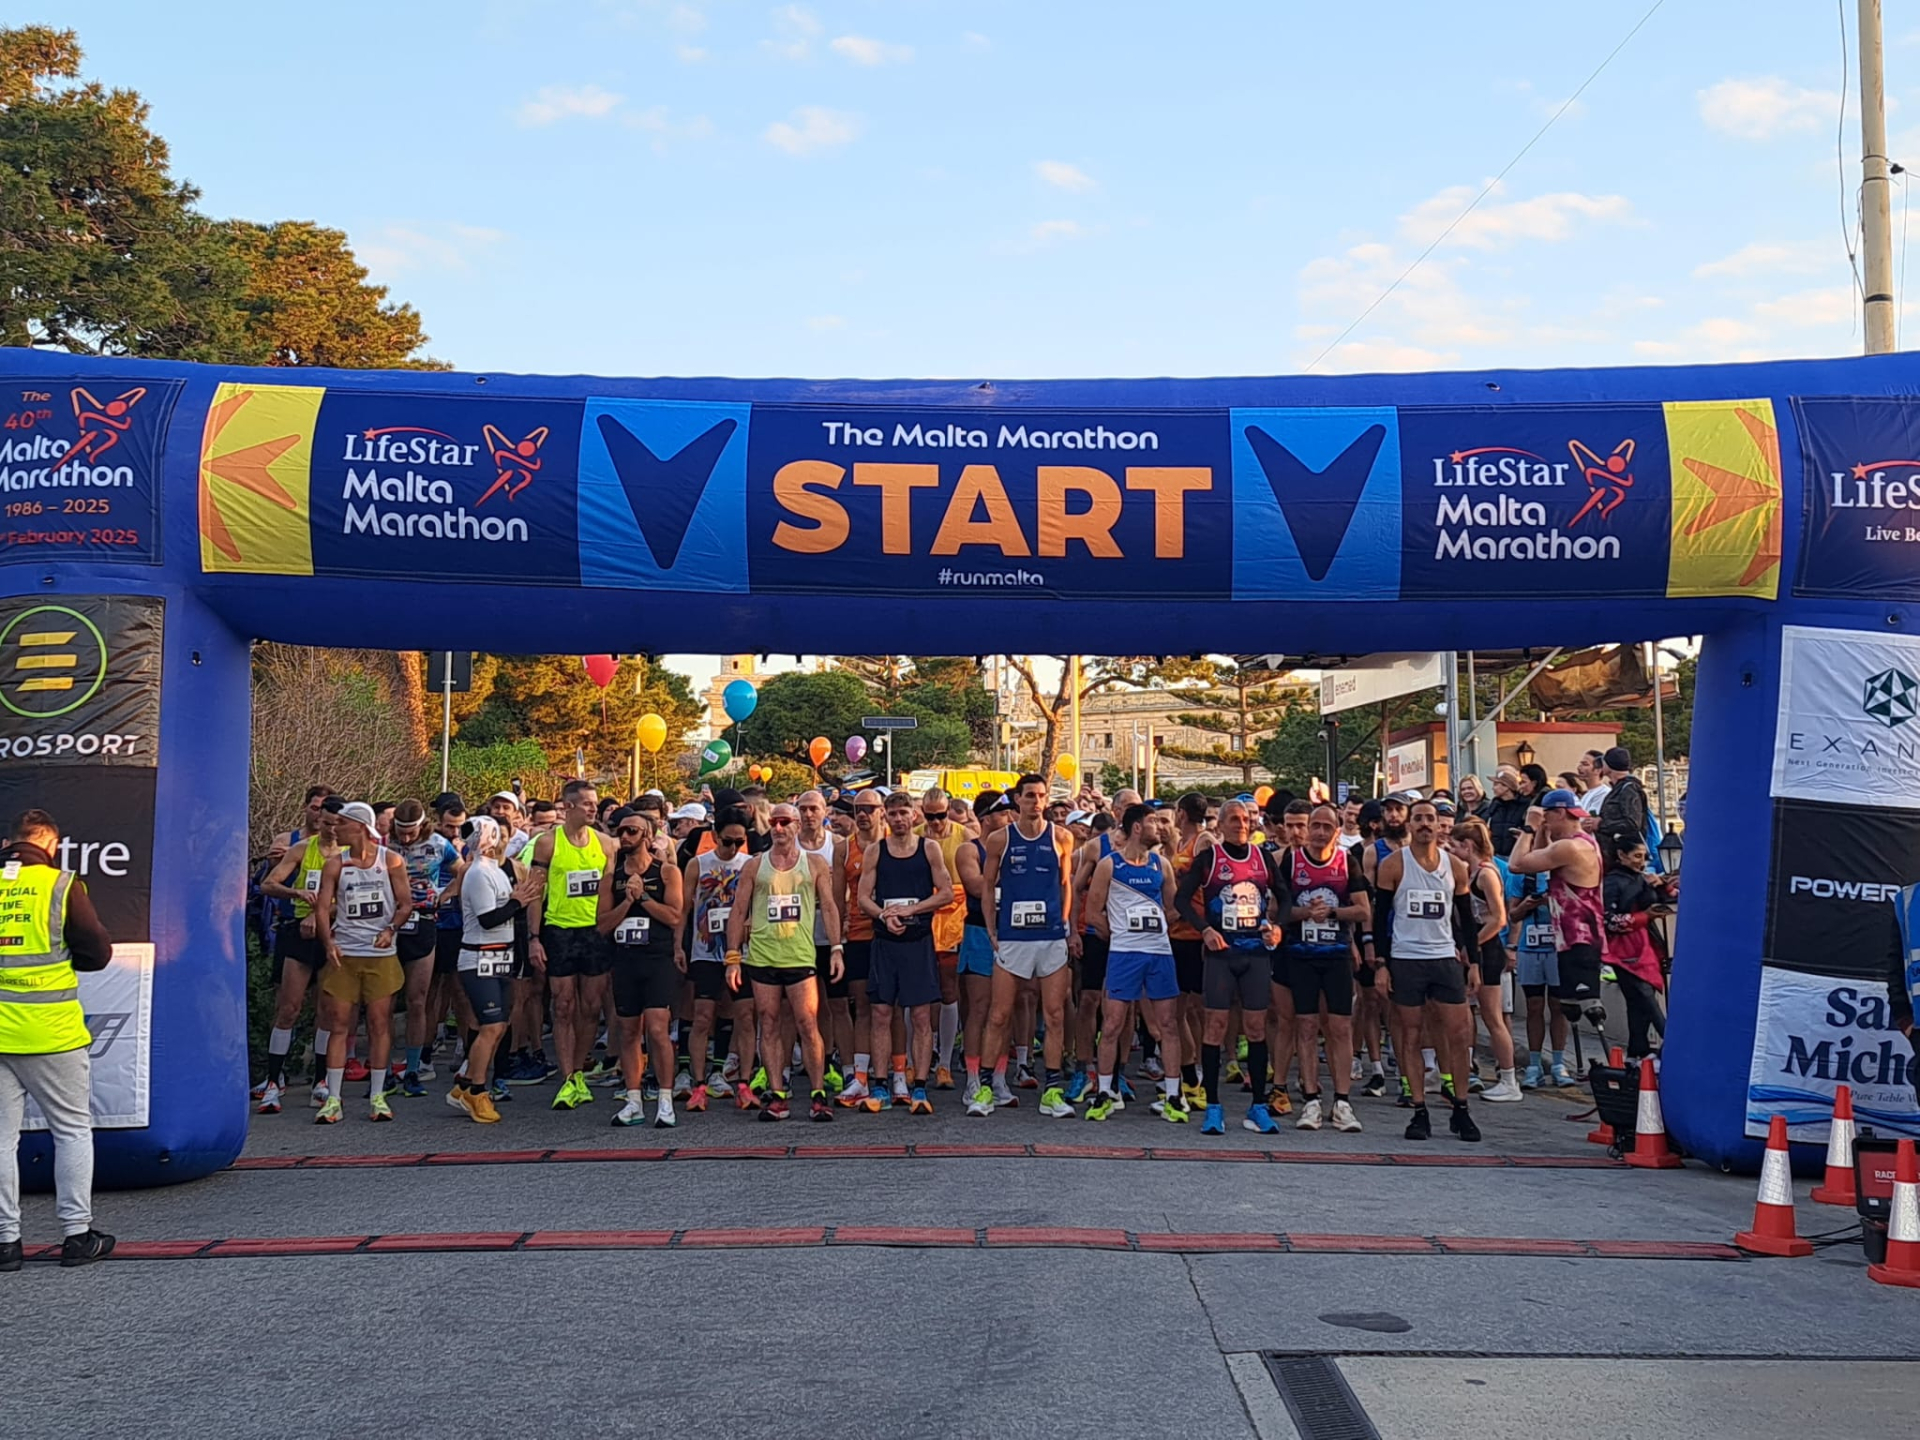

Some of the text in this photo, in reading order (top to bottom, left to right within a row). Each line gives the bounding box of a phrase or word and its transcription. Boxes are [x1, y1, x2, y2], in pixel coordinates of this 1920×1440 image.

[22, 391, 51, 401] The
[4, 410, 52, 430] 40th
[823, 422, 1159, 450] The Malta Marathon
[343, 434, 479, 466] LifeStar
[1433, 457, 1569, 486] LifeStar
[343, 468, 453, 504] Malta
[5, 501, 42, 517] 1986
[63, 499, 110, 513] 2025
[771, 459, 1213, 558] START
[1436, 494, 1546, 526] Malta
[343, 502, 528, 541] Marathon
[7, 530, 86, 544] February
[91, 529, 138, 544] 2025
[1865, 525, 1900, 540] Live
[1435, 529, 1620, 560] Marathon
[937, 568, 1044, 586] #runmalta
[367, 904, 378, 912] 15
[632, 931, 642, 939] 14
[1877, 1091, 1905, 1103] Table
